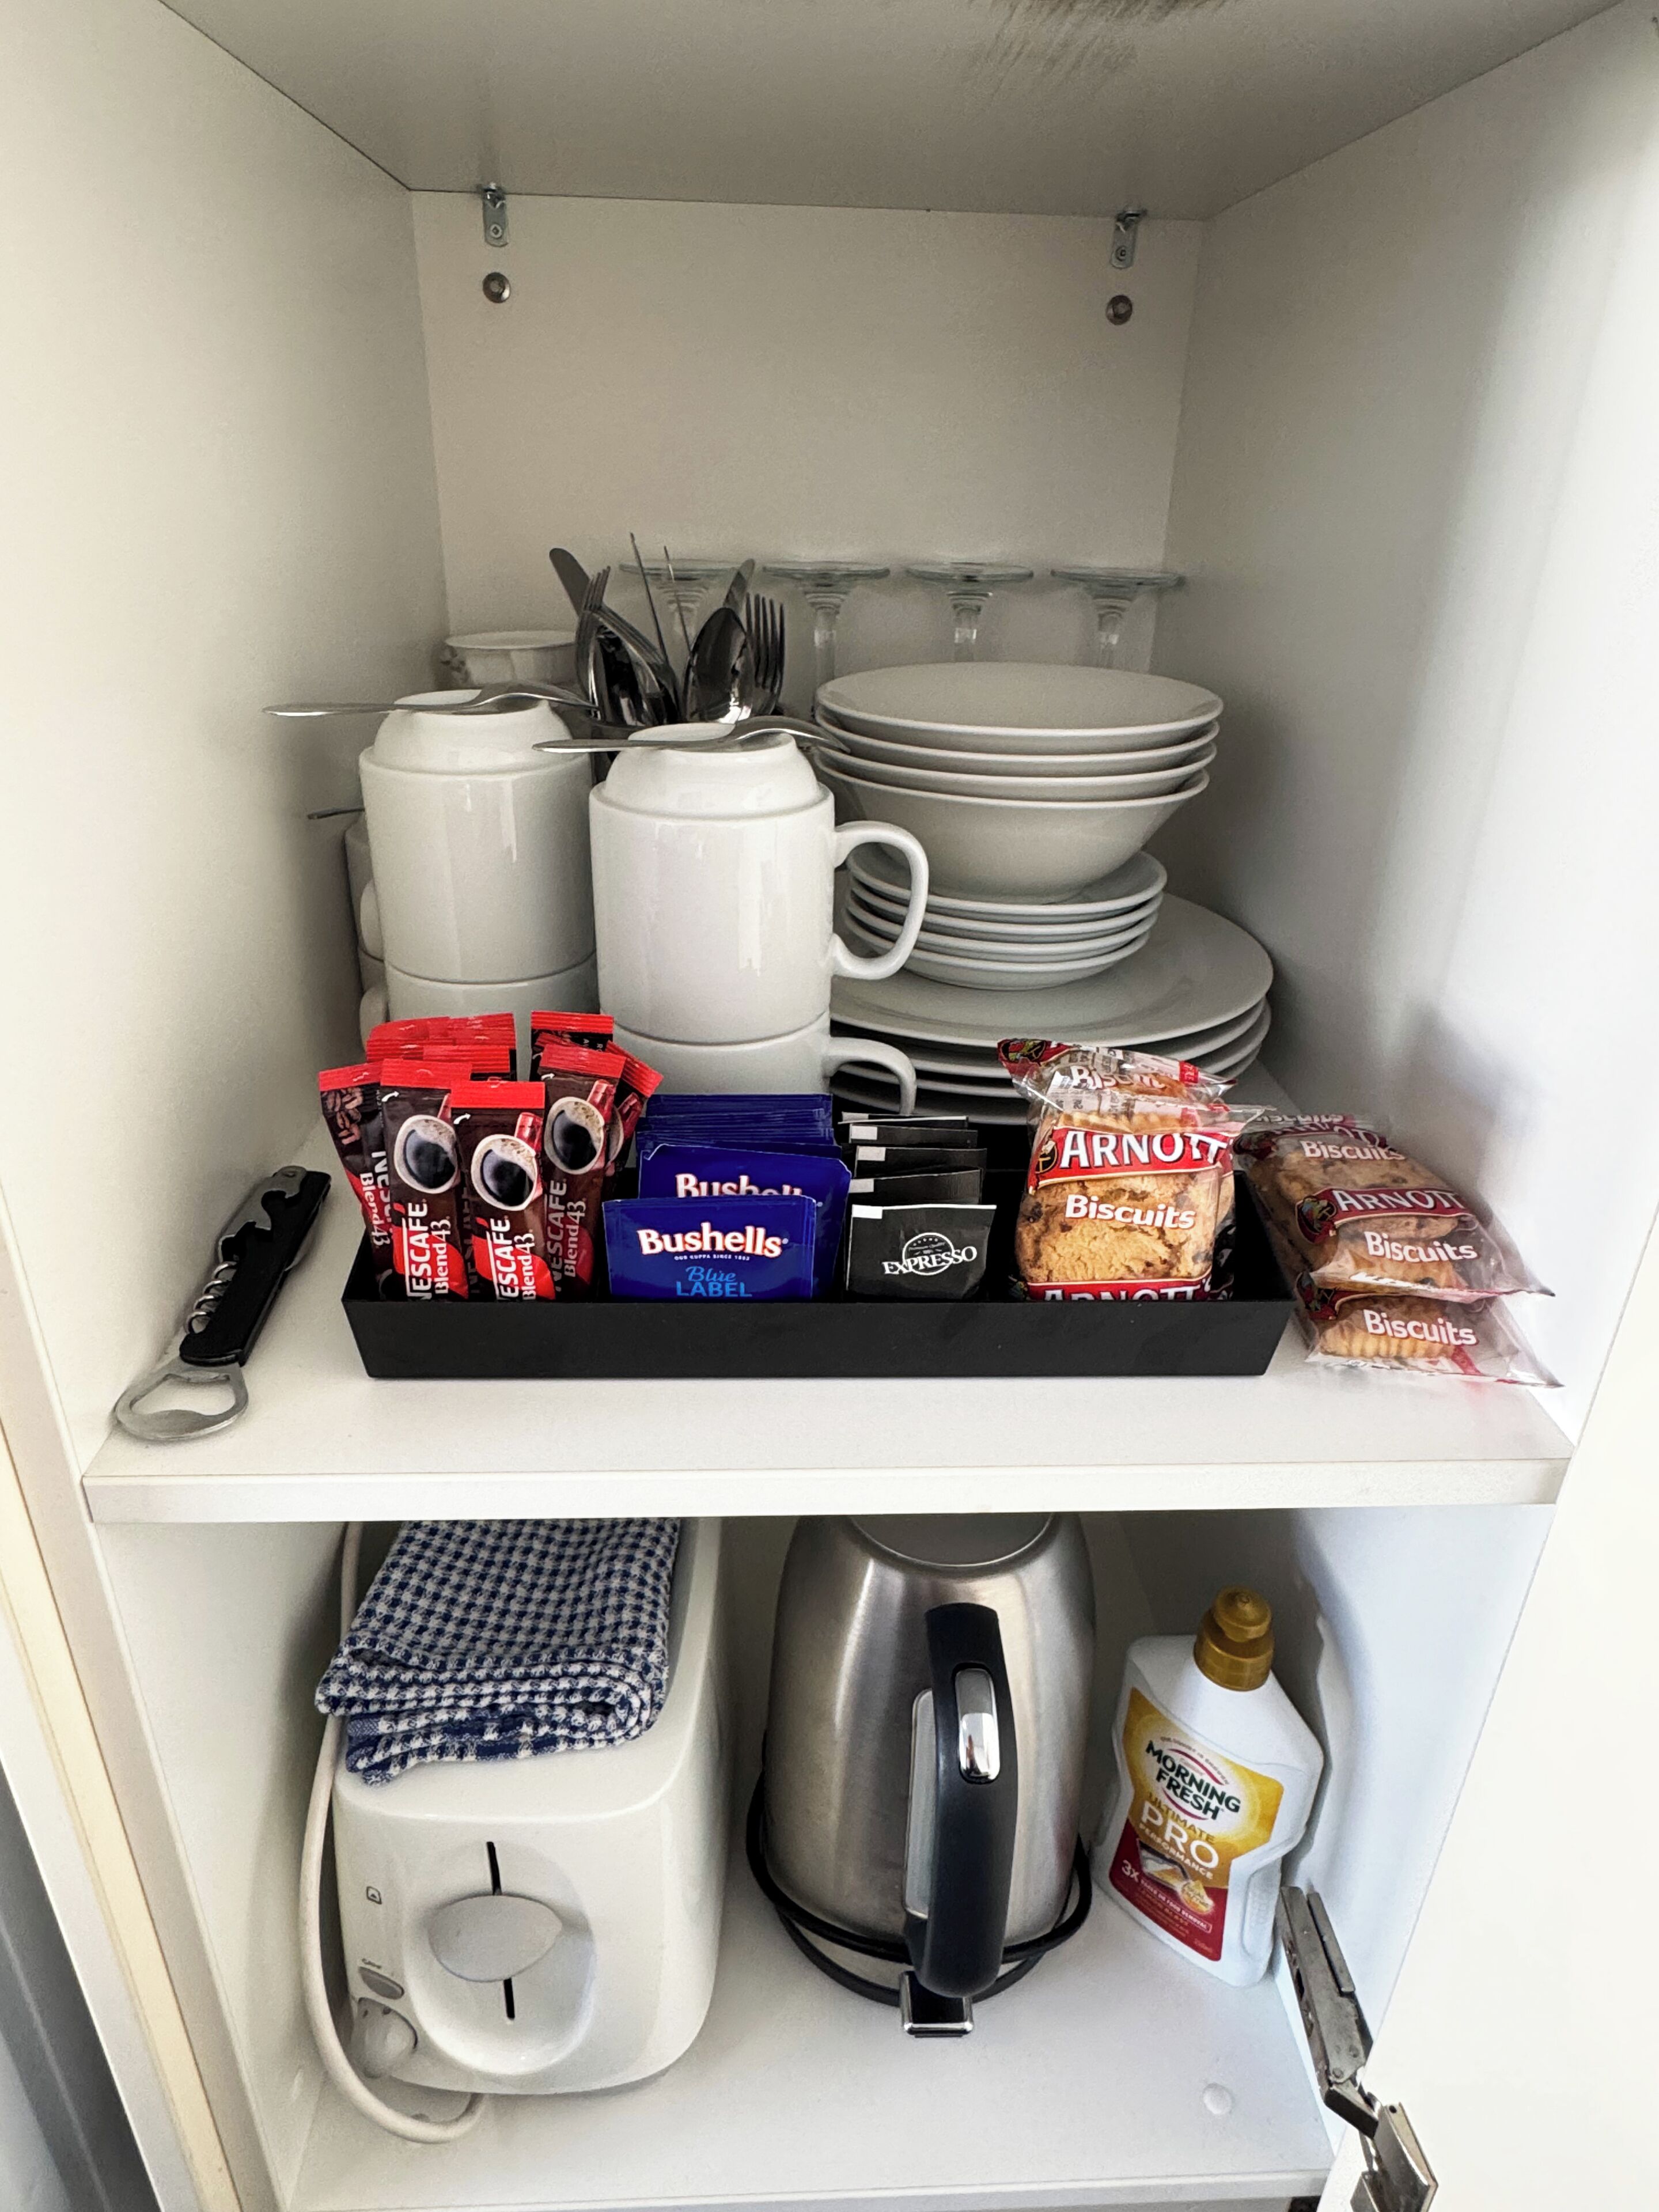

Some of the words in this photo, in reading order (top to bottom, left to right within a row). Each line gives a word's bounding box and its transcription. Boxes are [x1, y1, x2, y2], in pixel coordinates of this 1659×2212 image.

[1065, 1193, 1196, 1230] Biscuits
[637, 1221, 783, 1258] Bushells
[1364, 1230, 1479, 1263] Biscuits
[685, 1265, 737, 1282] Blue
[881, 1245, 978, 1275] EXPRESSO
[676, 1281, 753, 1297] LABEL
[1363, 1309, 1478, 1346] Biscuits
[1145, 1740, 1241, 1813] MORNING
[1156, 1767, 1220, 1820] FRESH
[1140, 1800, 1219, 1869] PRO
